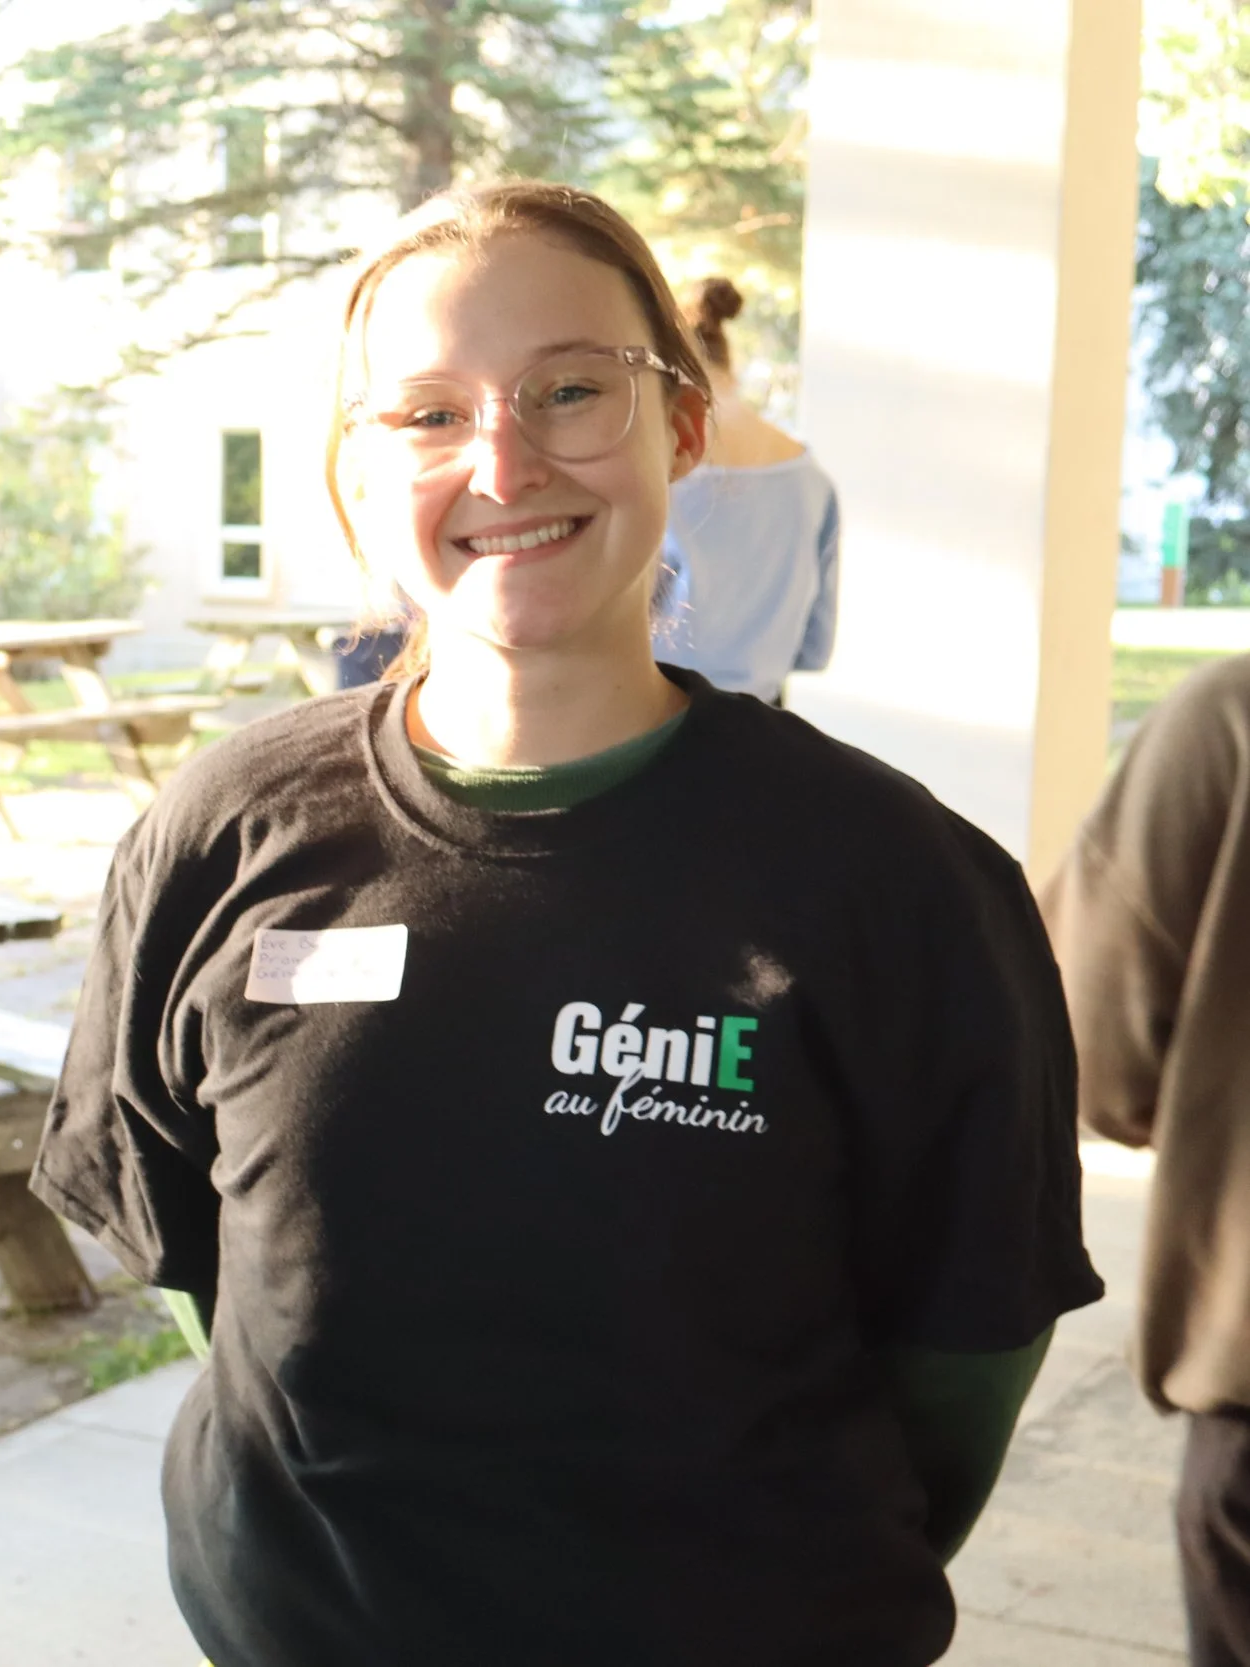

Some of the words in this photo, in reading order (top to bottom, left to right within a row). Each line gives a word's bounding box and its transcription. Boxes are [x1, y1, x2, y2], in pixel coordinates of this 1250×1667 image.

[550, 1001, 759, 1093] GéniE
[543, 1090, 599, 1116] au
[599, 1062, 770, 1137] féminin
